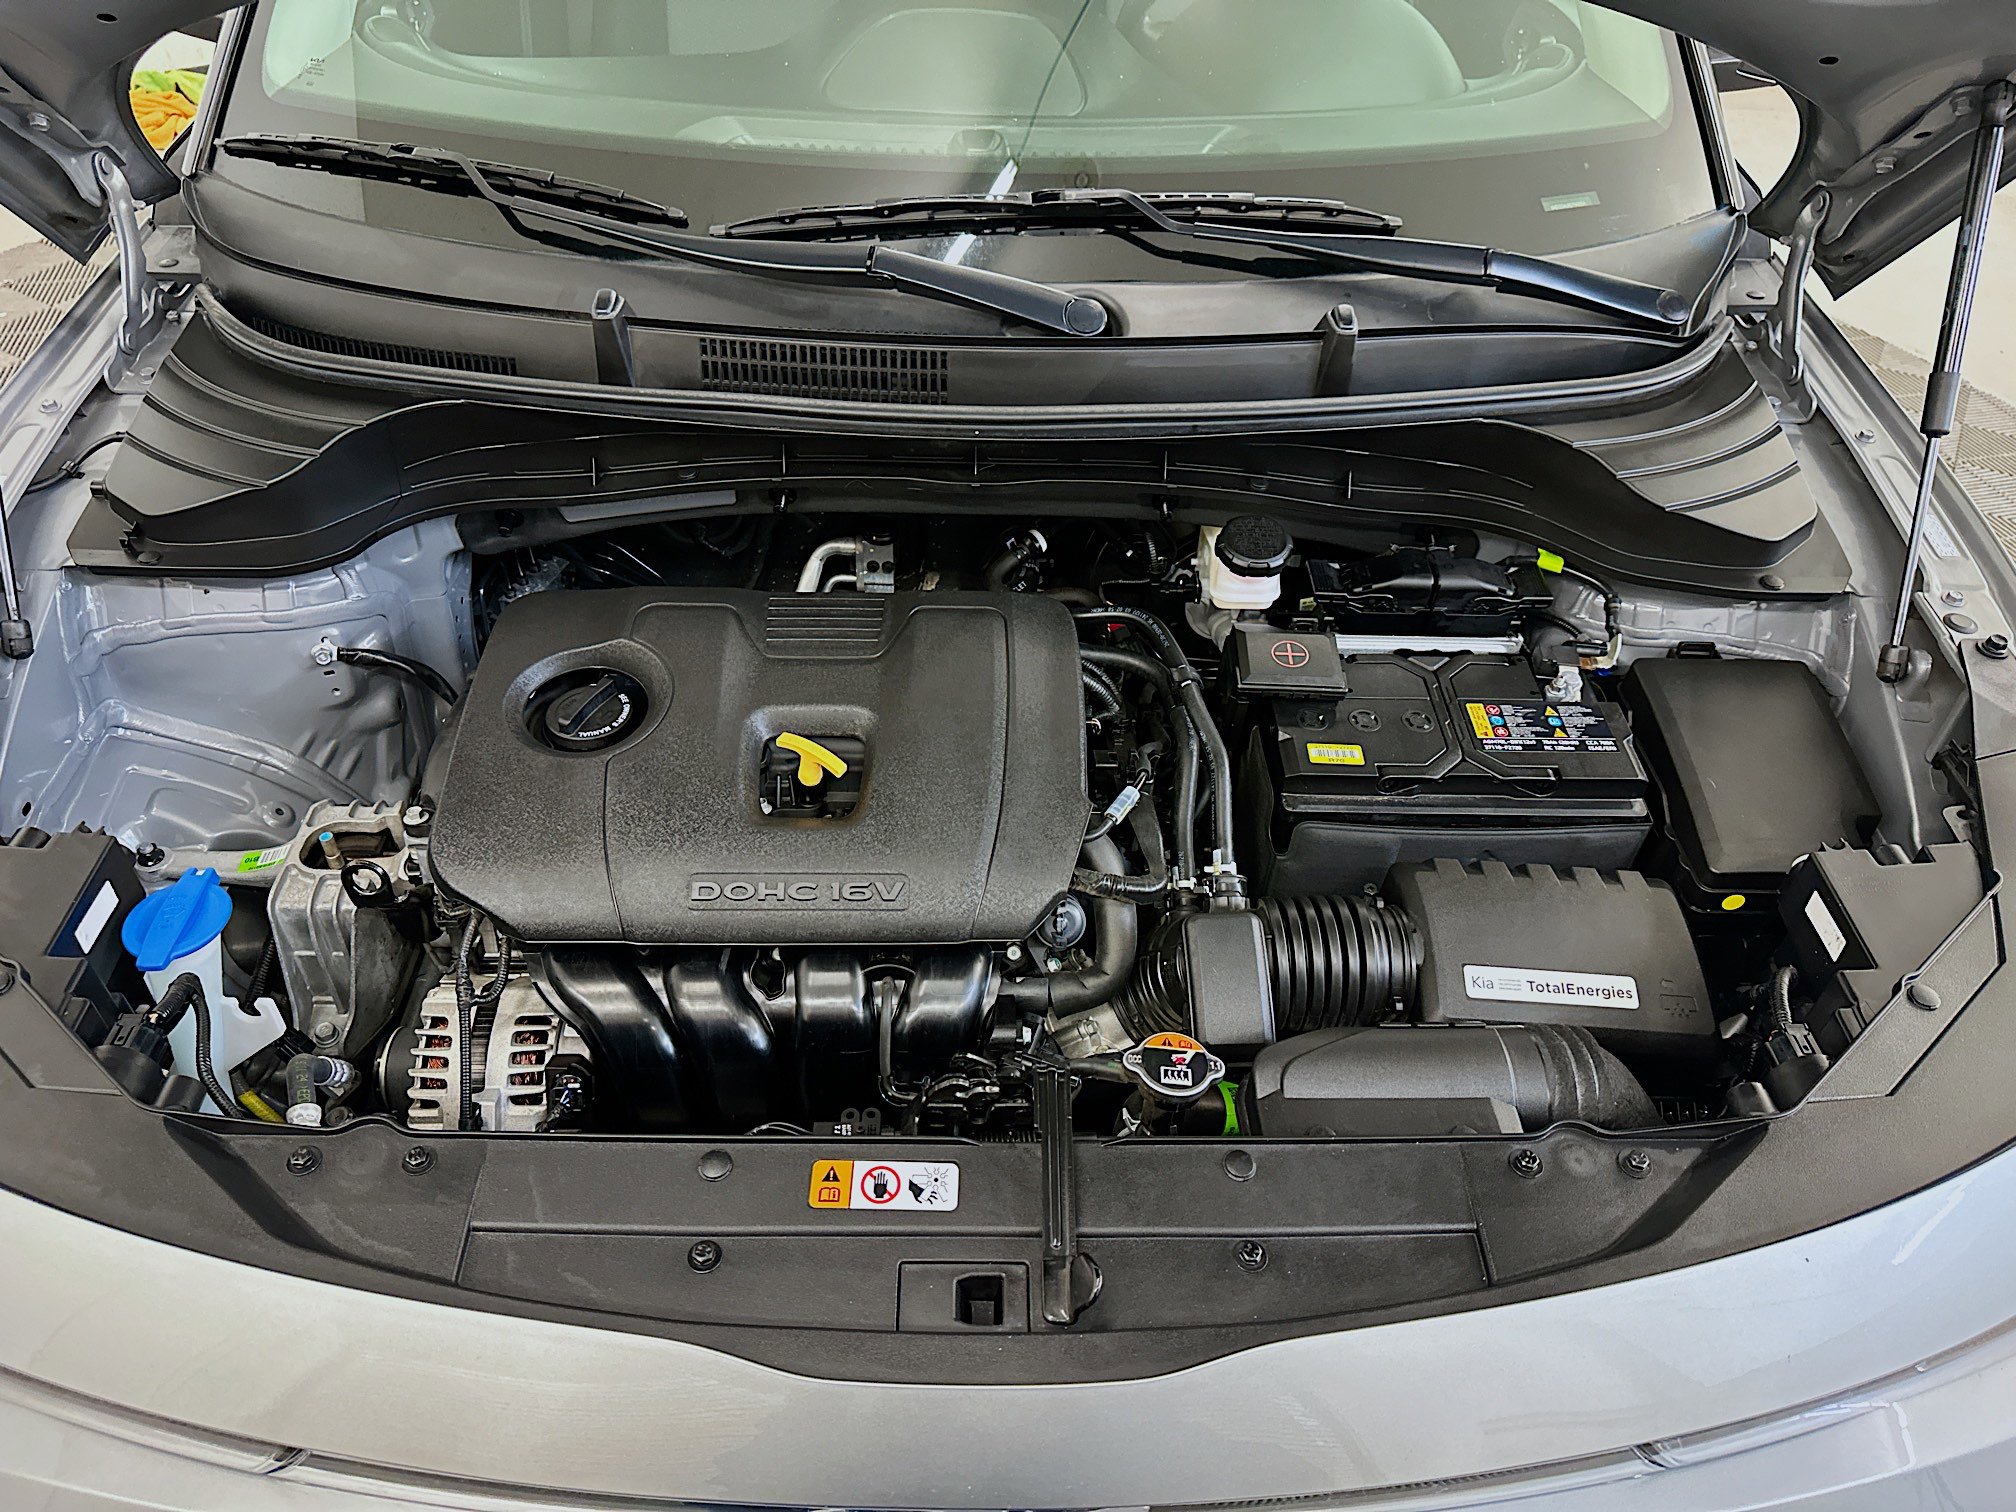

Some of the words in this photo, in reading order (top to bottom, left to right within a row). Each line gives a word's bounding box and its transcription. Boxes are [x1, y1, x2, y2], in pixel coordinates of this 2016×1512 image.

[618, 693, 630, 703] SEE
[578, 725, 612, 738] MANUAL
[690, 881, 818, 902] DOHC
[830, 881, 906, 902] 16V
[1472, 975, 1494, 990] Kia
[1526, 980, 1633, 999] TotalEnergies
[1209, 1060, 1222, 1071] 1.1
